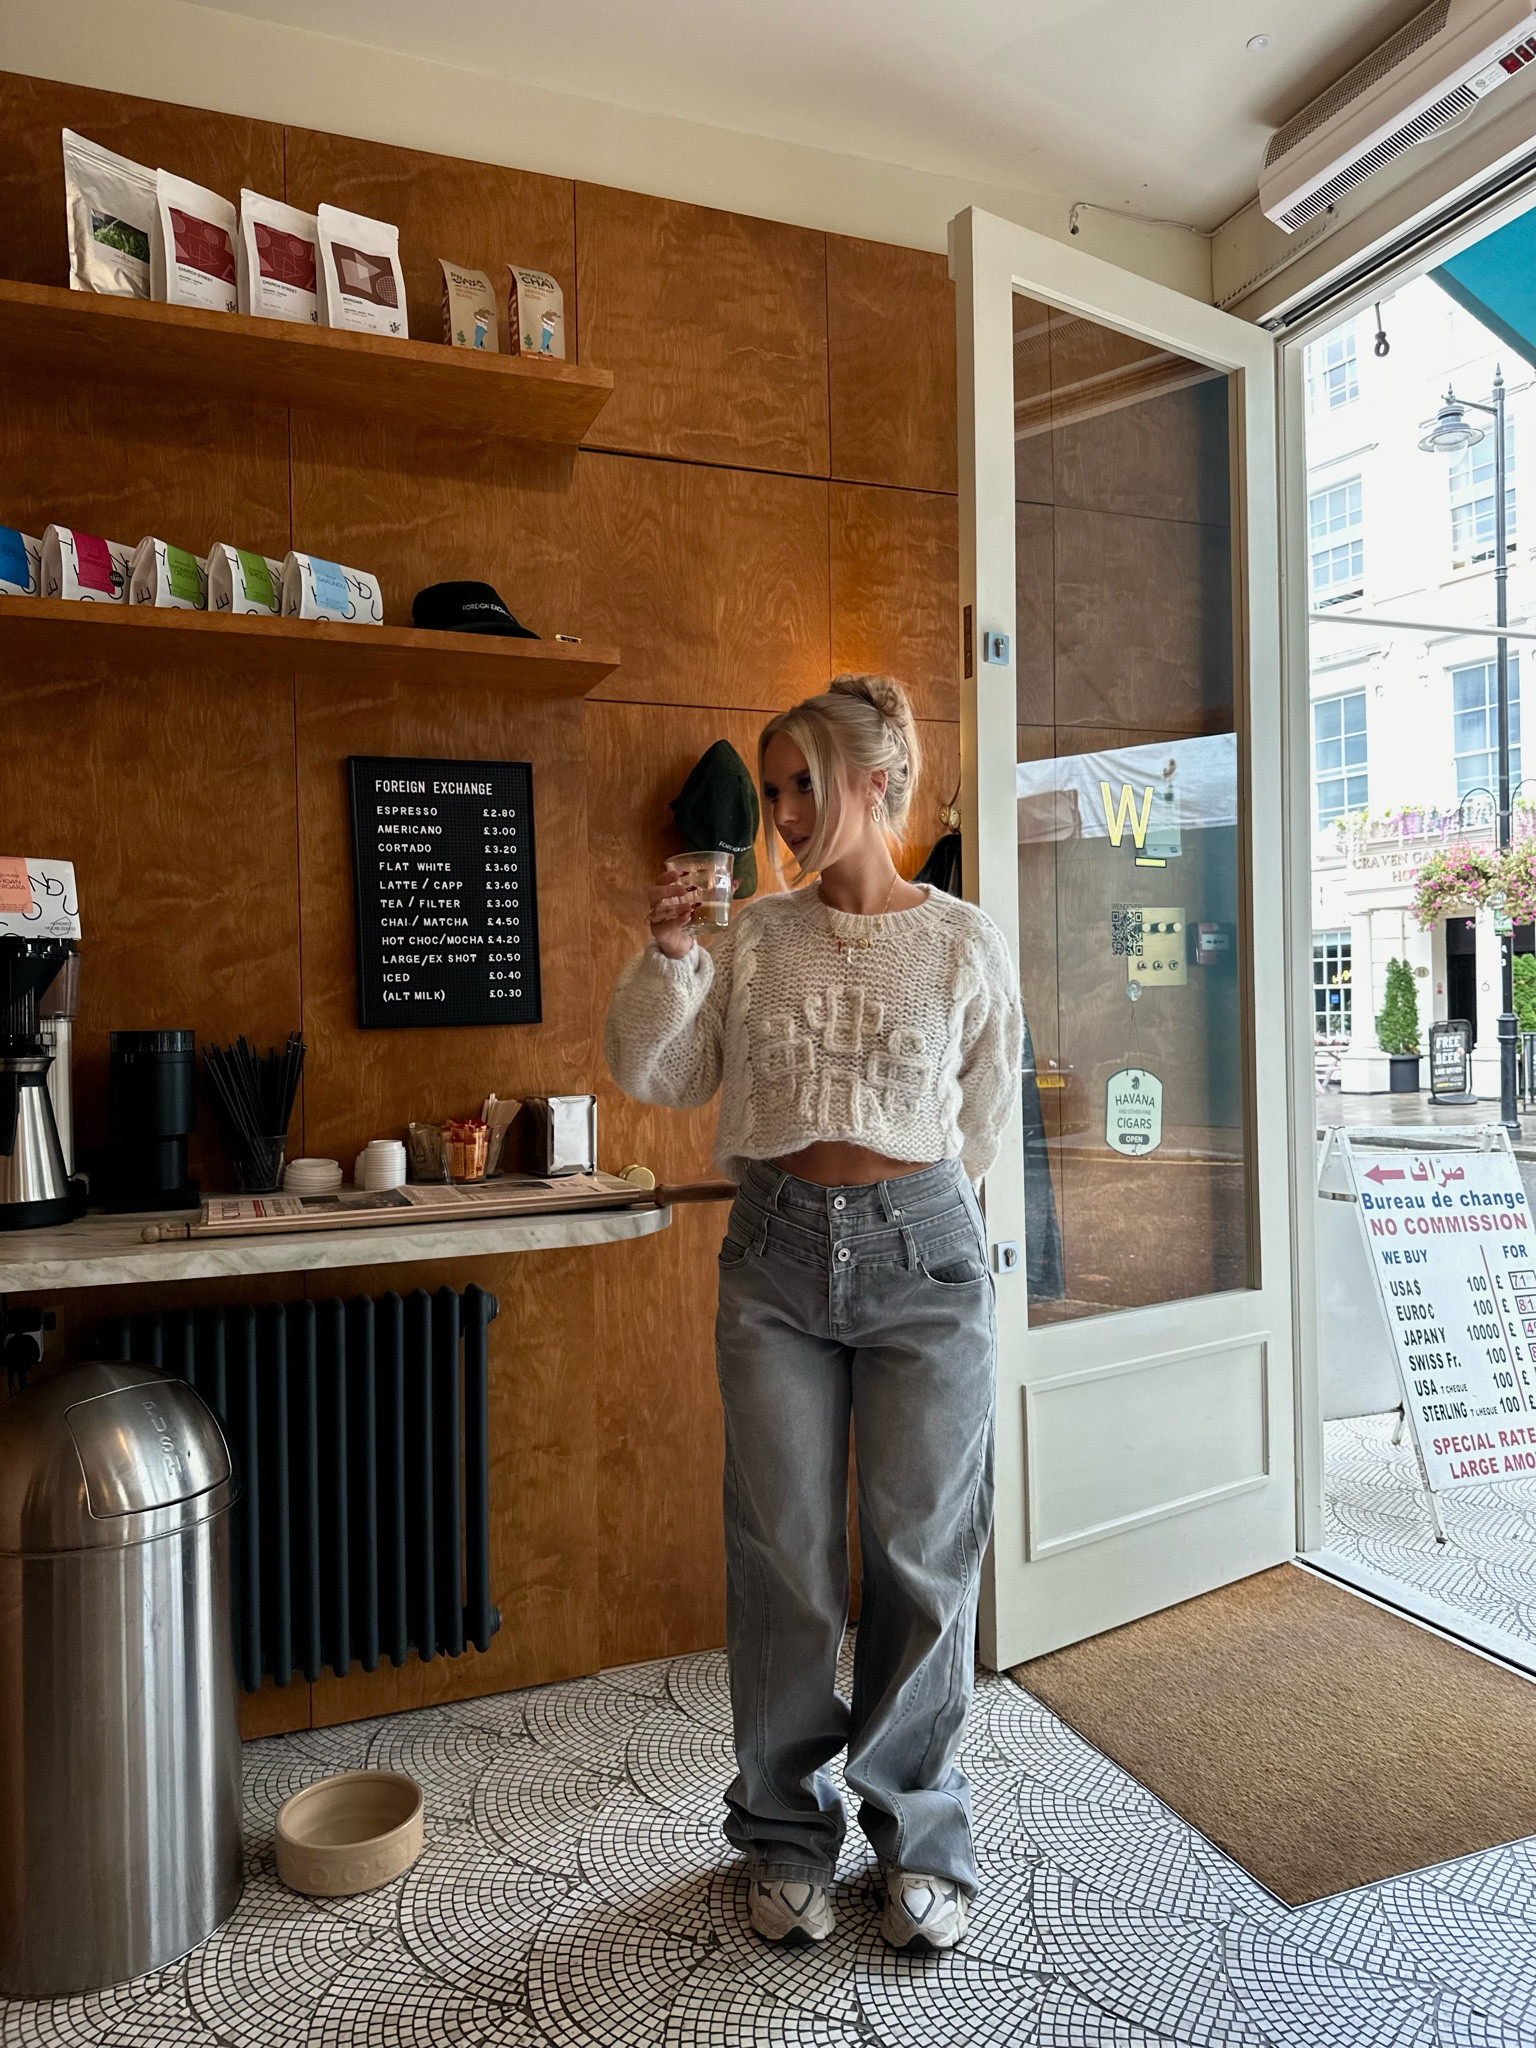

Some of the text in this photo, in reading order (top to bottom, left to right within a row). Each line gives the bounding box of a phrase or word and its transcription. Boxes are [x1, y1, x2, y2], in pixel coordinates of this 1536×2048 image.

[376, 780, 492, 795] FOREIGN EXCHANGE
[377, 806, 515, 817] ESPRESSO £2.80
[378, 825, 516, 835] AMERICANO £3.00
[378, 843, 517, 854] CORTADO £3.20
[380, 862, 517, 872] FLAT WHITE £3.60
[1352, 852, 1408, 870] CRAVEN
[380, 881, 418, 889] LATTE
[434, 881, 463, 890] CAPP
[486, 881, 518, 889] £3.60
[381, 900, 403, 908] TEA
[420, 900, 460, 908] FILTER
[487, 900, 518, 908] £3.00
[423, 918, 468, 926] MATCHA
[487, 918, 519, 926] £4.50
[382, 937, 404, 945] HOT
[488, 936, 520, 944] £4.20
[448, 954, 477, 963] SHOT
[489, 953, 521, 962] £0.50
[383, 971, 521, 982] ICED £0.40
[383, 990, 522, 1002] (ALT MILK) £0.30
[1436, 1035, 1461, 1049] FREE
[1115, 1094, 1155, 1108] HAVANA
[1117, 1117, 1152, 1129] CIGARS
[1361, 1190, 1525, 1210] Bureau de change
[1370, 1213, 1528, 1236] NO COMMISSION
[1382, 1244, 1528, 1265] WE BUY FOR
[1390, 1278, 1421, 1296] USA$
[1467, 1276, 1487, 1291] 100
[1473, 1300, 1493, 1316] 100
[1467, 1323, 1500, 1341] 10000
[1409, 1353, 1444, 1371] SWISS
[1446, 1352, 1461, 1368] Fr.
[1486, 1347, 1506, 1364] 100
[1414, 1379, 1438, 1396] USA
[1493, 1371, 1513, 1389] 100
[1422, 1402, 1467, 1422] STERLING
[1499, 1396, 1520, 1413] 100
[142, 1401, 182, 1475] PUSH
[1433, 1432, 1496, 1455] SPECIAL
[1450, 1457, 1500, 1479] LARGE
